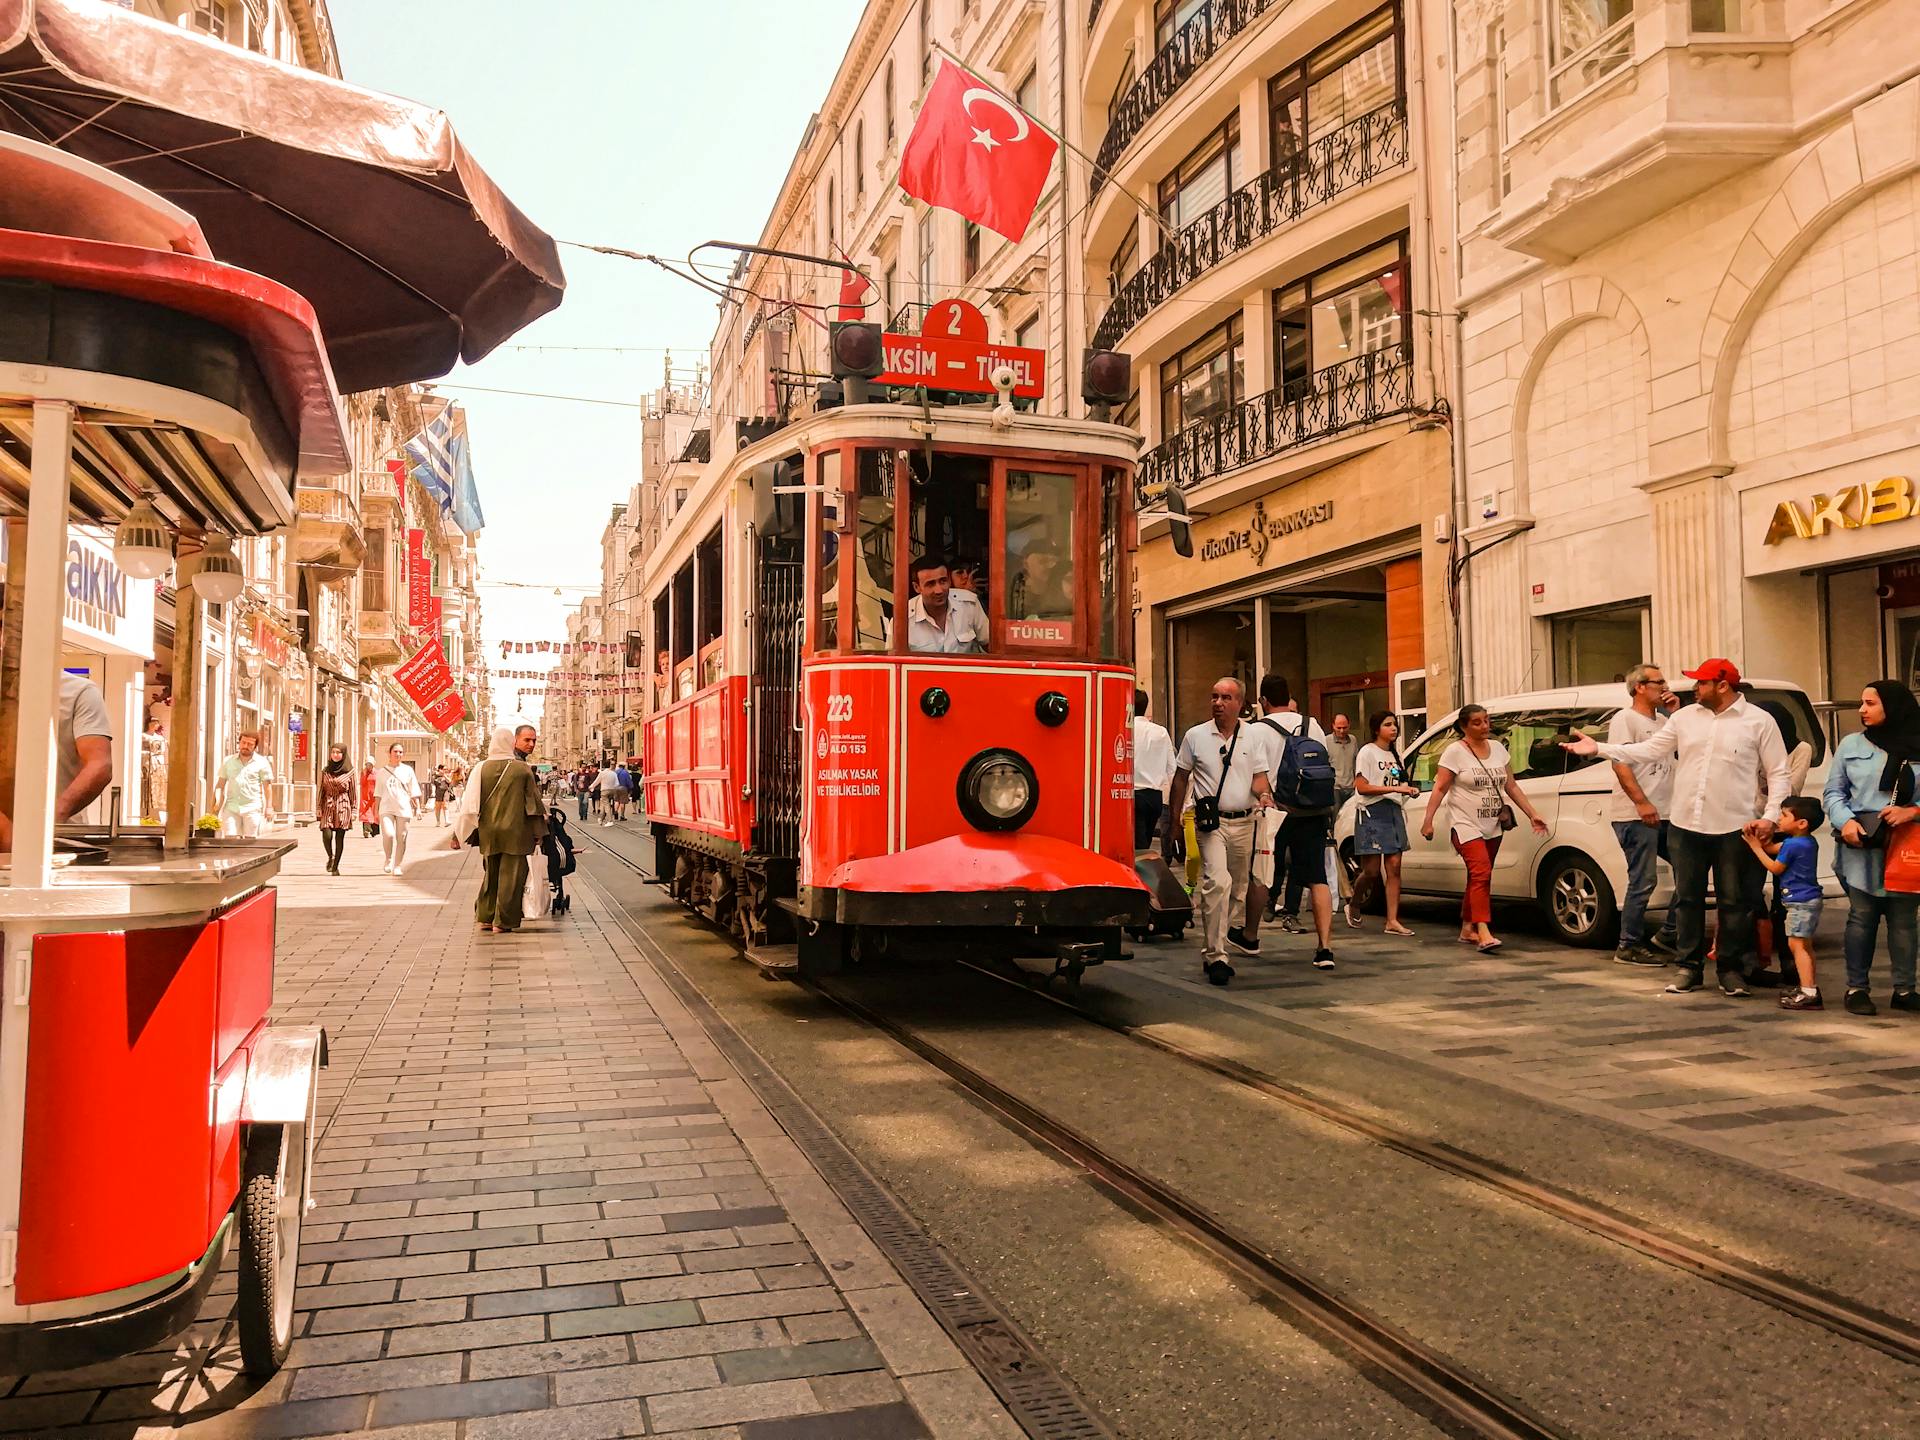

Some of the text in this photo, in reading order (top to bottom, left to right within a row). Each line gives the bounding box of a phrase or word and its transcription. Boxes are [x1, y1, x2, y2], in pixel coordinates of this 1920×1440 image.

[947, 303, 962, 335] 2
[882, 343, 936, 376] AKSİM
[1763, 476, 1920, 546] AKB
[1201, 530, 1251, 562] TÜRKİYE
[1268, 500, 1333, 539] BANKASI
[1010, 624, 1064, 640] TÜNEL
[827, 694, 853, 721] 223
[849, 744, 867, 753] 153
[818, 769, 879, 780] ASILMAK YASAK
[817, 783, 881, 797] VE TEHLİKELİDİR
